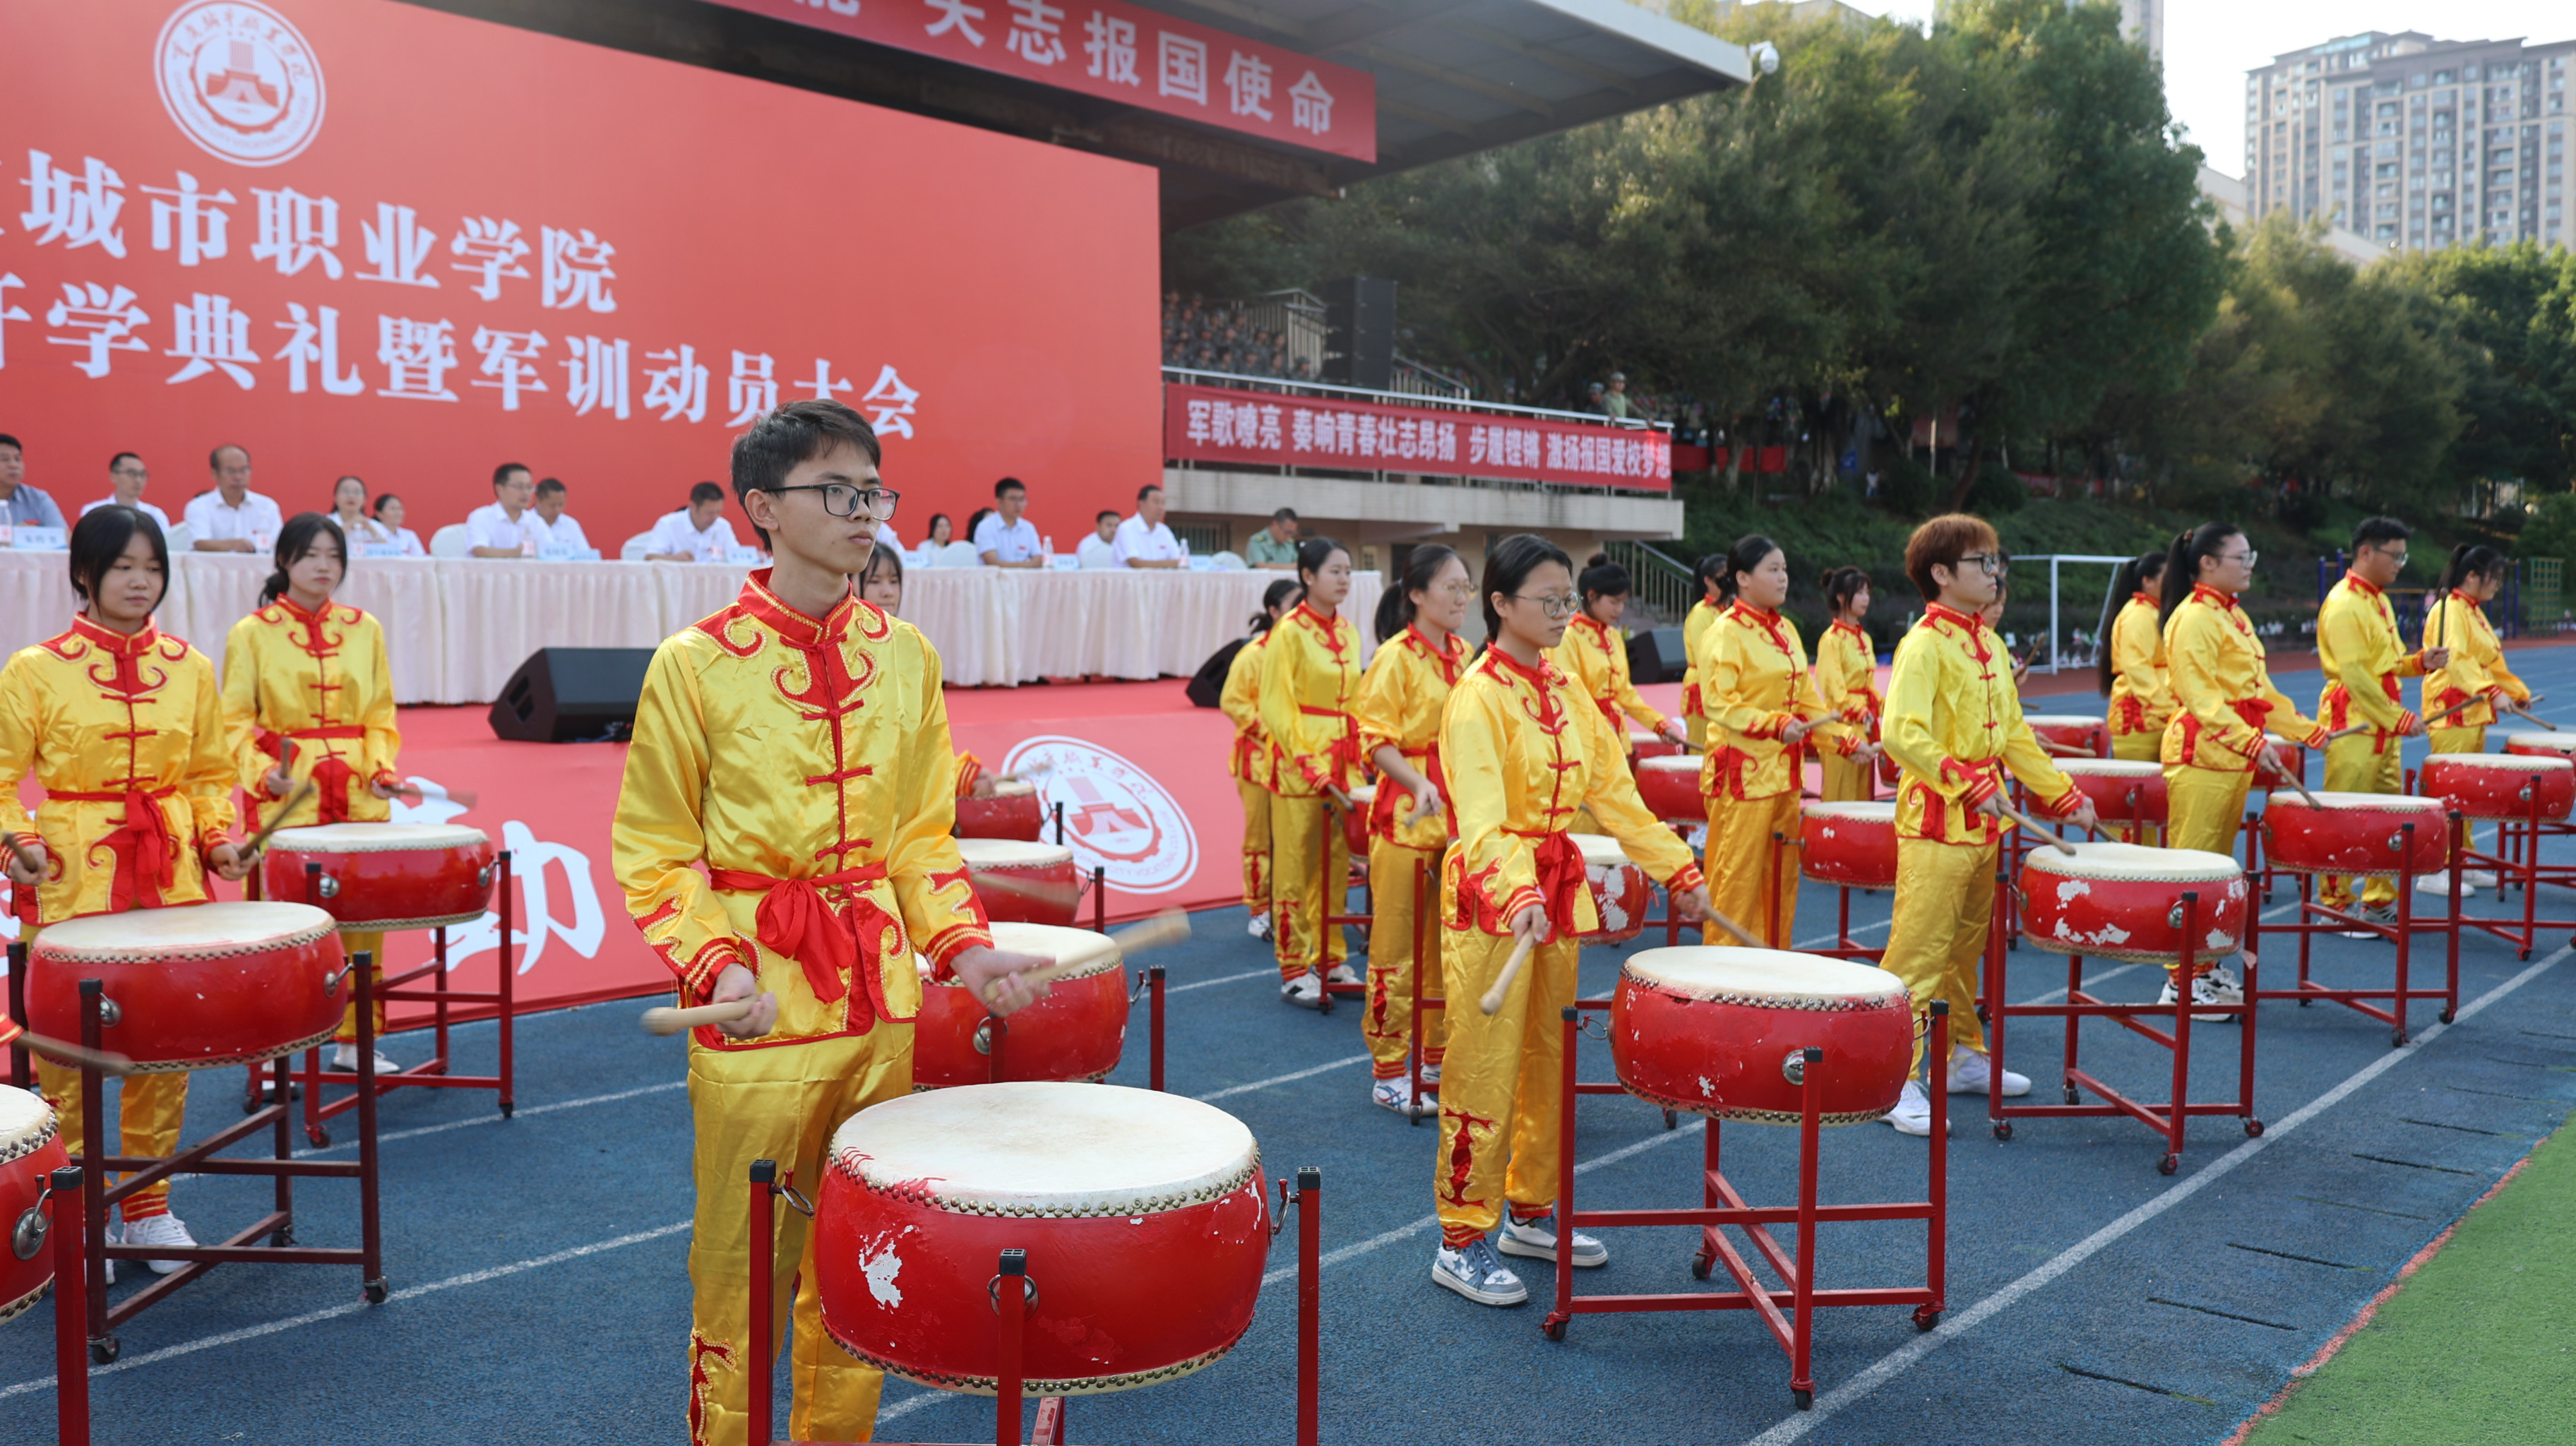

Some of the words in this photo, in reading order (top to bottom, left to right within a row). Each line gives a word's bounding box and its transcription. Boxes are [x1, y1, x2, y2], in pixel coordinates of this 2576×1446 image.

[0, 148, 617, 313] 城市职业学院
[1186, 400, 1282, 450] 军歌嘹亮
[1292, 408, 1457, 462] 奏响青春壮志昂扬
[1469, 424, 1540, 470] 步履铿锵
